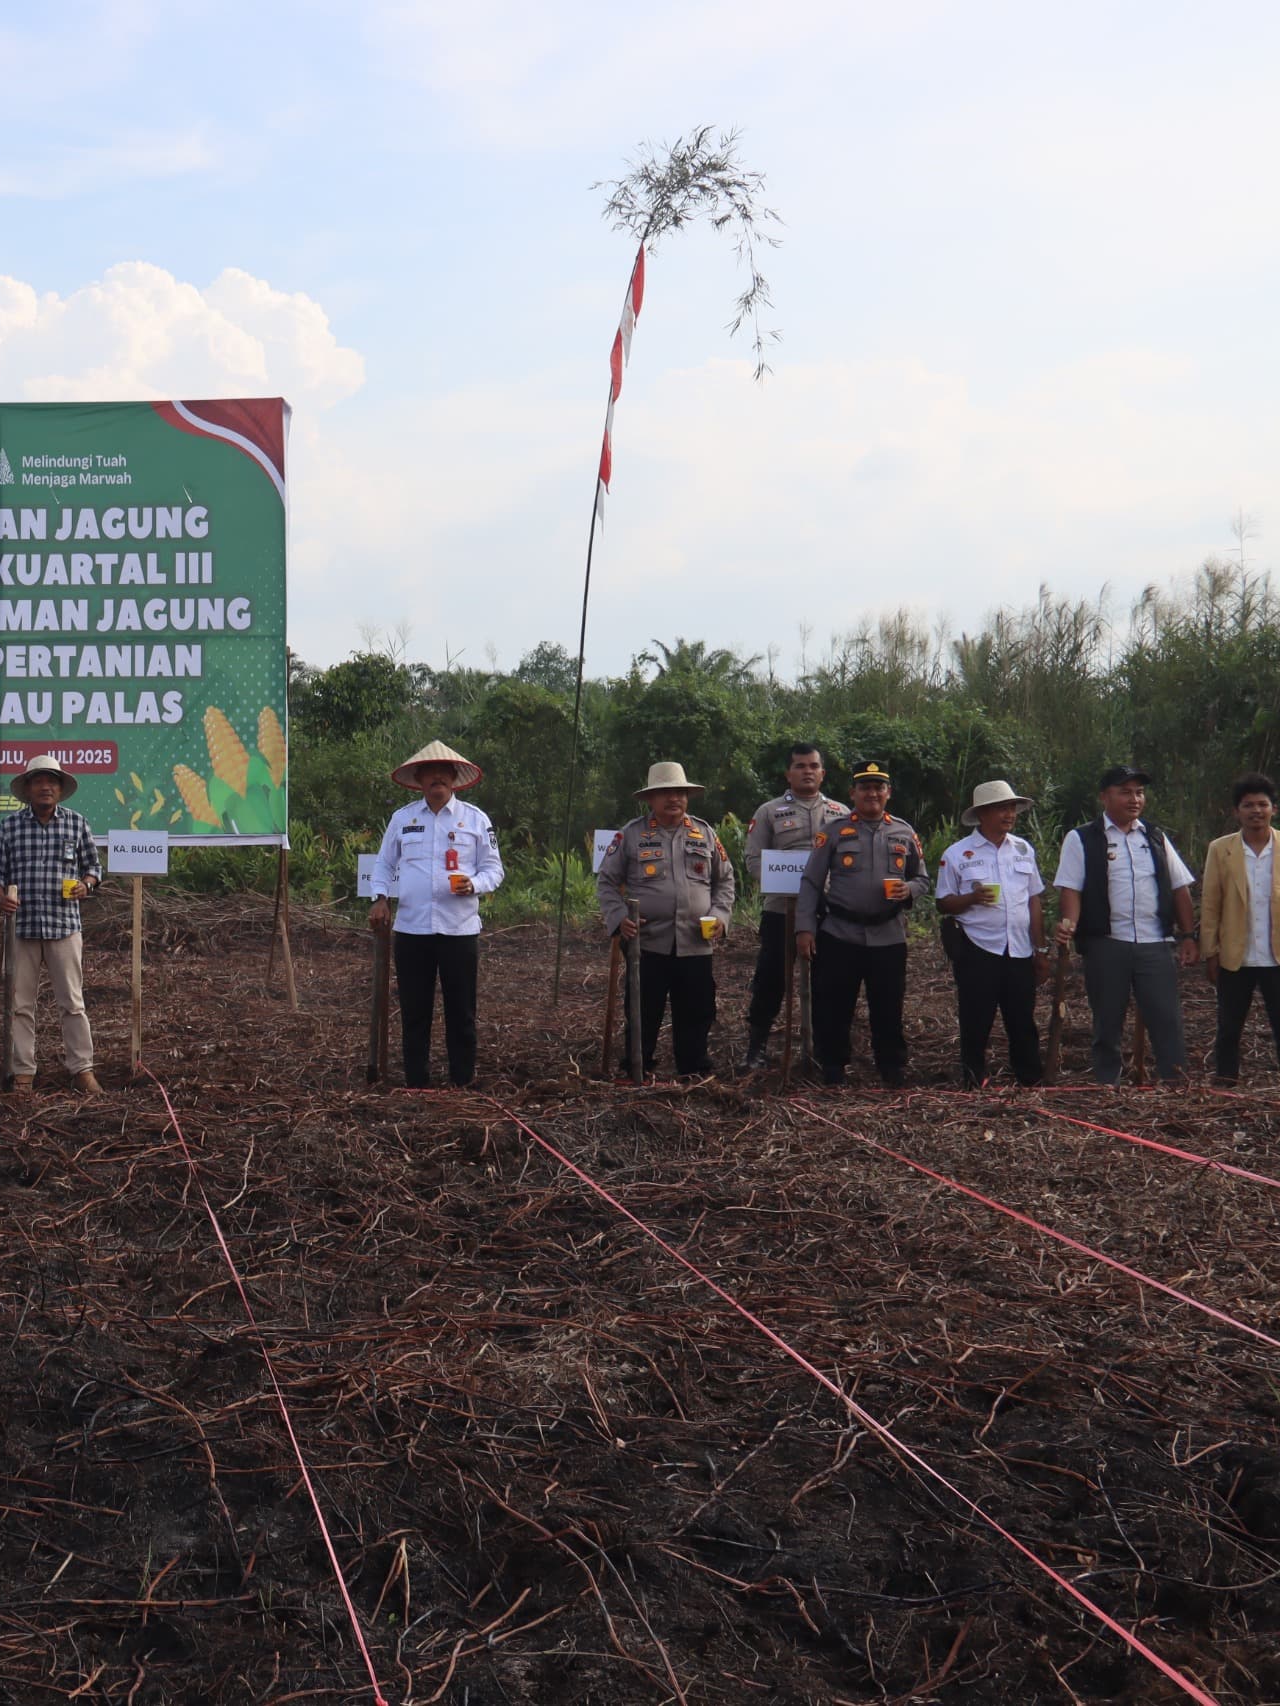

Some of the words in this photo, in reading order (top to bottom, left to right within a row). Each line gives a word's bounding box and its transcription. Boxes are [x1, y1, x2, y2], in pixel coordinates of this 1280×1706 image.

[22, 454, 93, 470] Melindungi
[96, 454, 127, 467] Tuah
[22, 472, 76, 488] Menjaga
[79, 472, 132, 485] Marwah
[55, 506, 209, 540] JAGUNG
[175, 552, 213, 584] III
[96, 597, 252, 631] JAGUNG
[63, 690, 183, 723] PALAS
[76, 749, 112, 764] 2025
[113, 845, 128, 853] KA.
[131, 845, 163, 854] BULOG
[768, 863, 806, 873] KAPOLS
